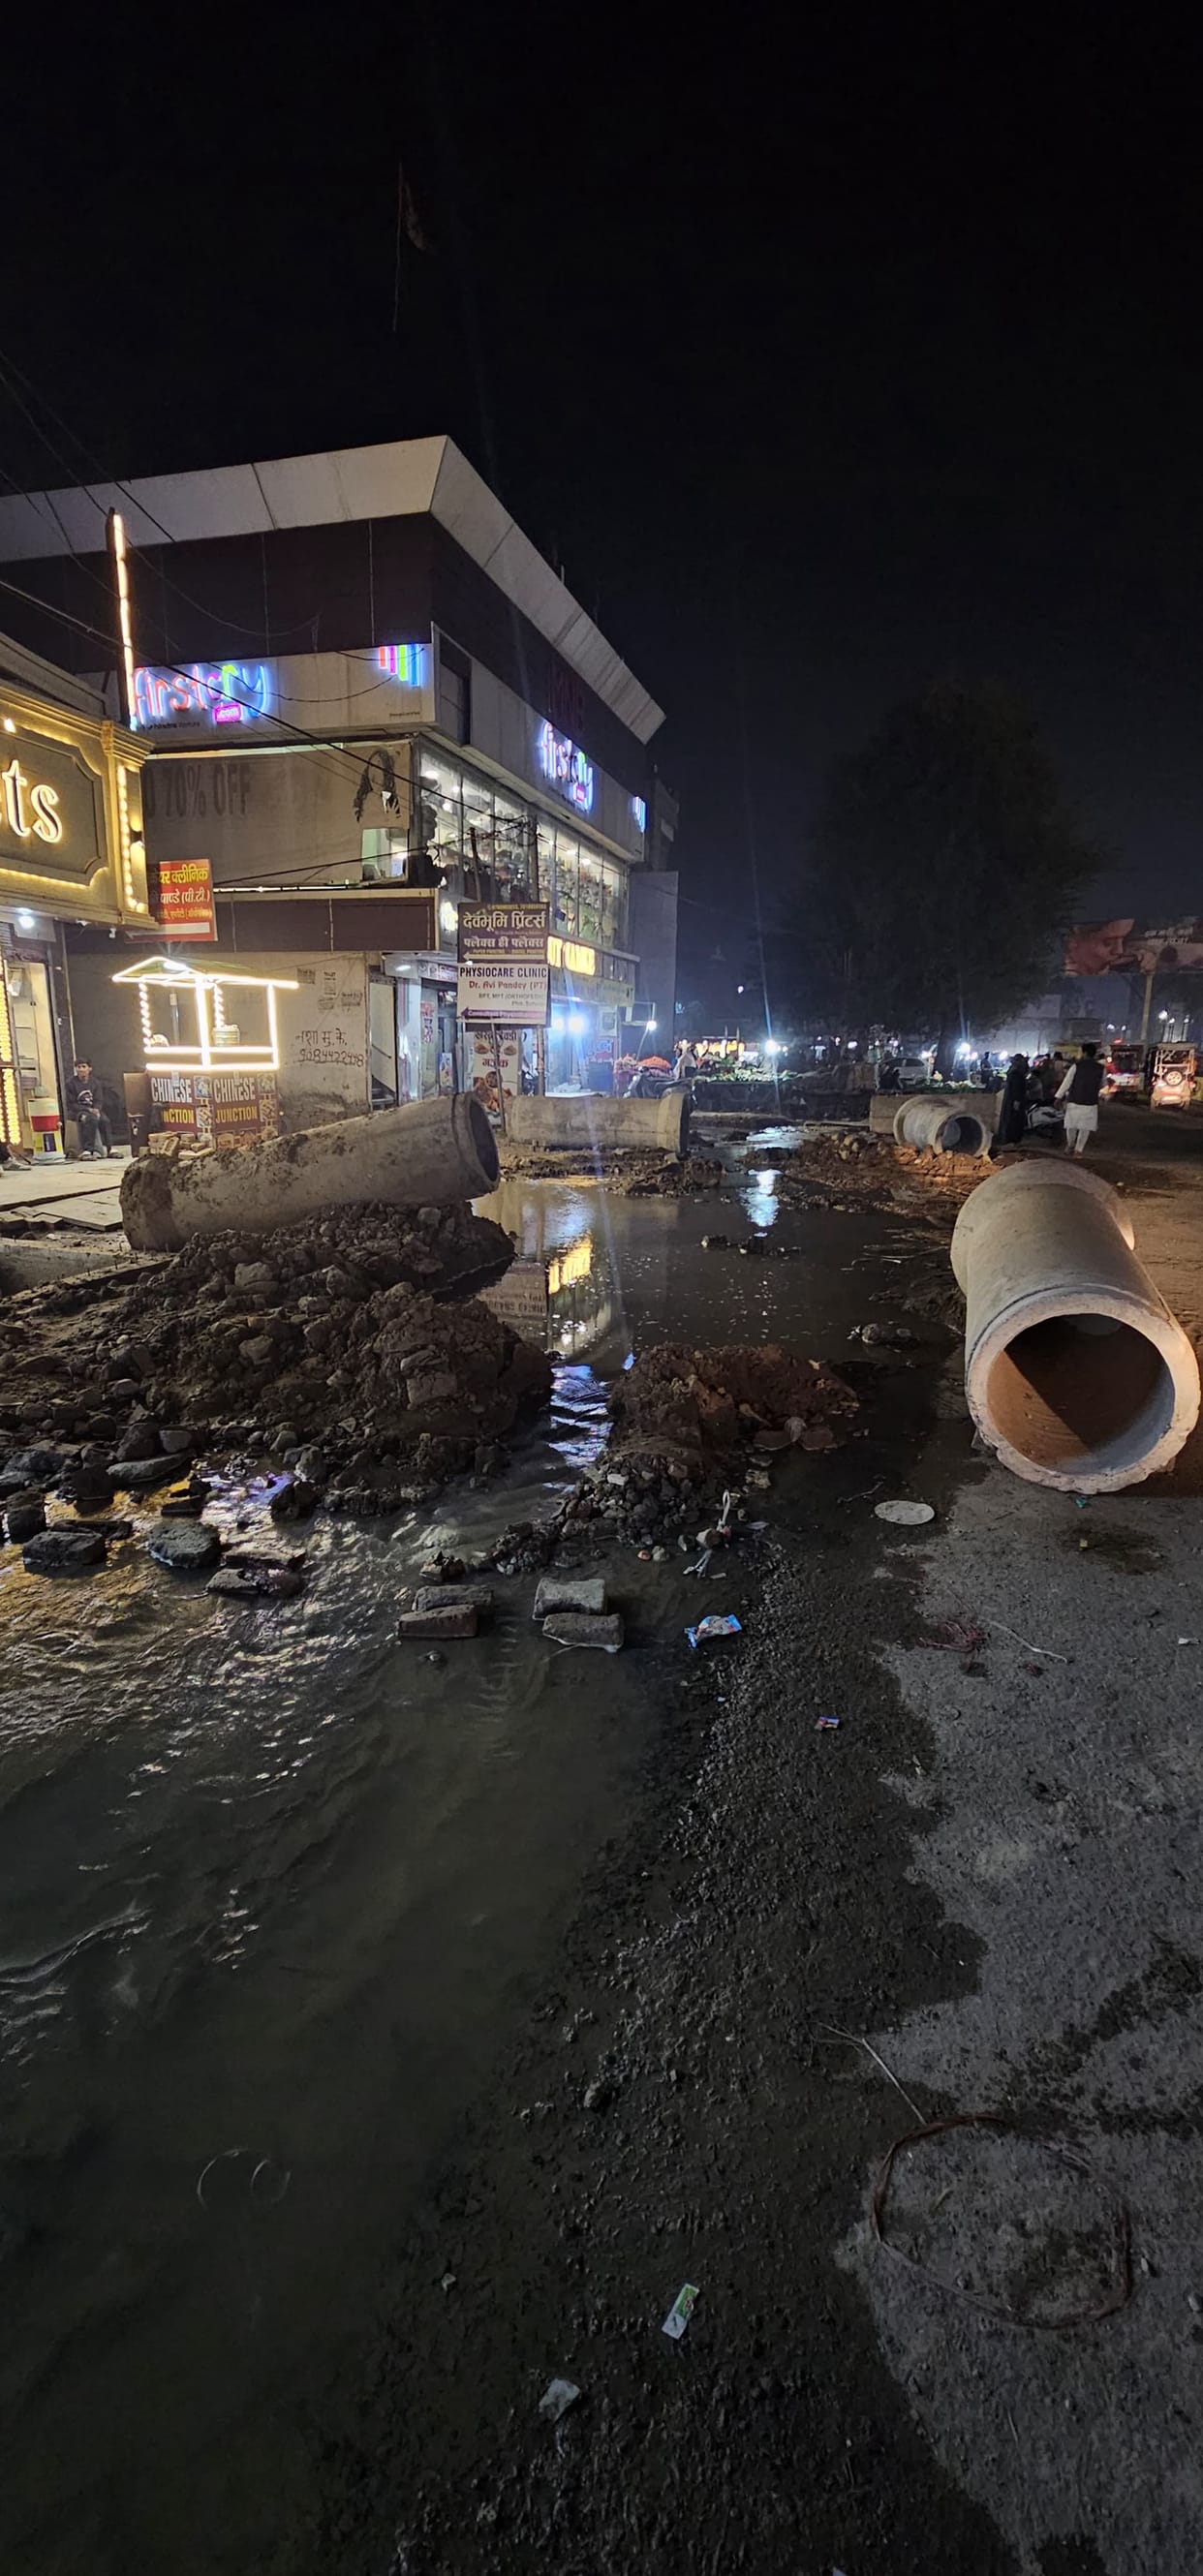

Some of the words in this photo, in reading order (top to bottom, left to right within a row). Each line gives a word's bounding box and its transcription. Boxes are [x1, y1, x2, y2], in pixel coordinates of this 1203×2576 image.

[0, 759, 63, 843] ts
[459, 966, 514, 977] PHYSIOCARE
[517, 966, 547, 978] CLINIC
[469, 980, 480, 989] Dr.
[213, 1077, 256, 1103] CHINESE
[162, 1107, 195, 1124] NCTION
[215, 1106, 258, 1124] JUNCTION
